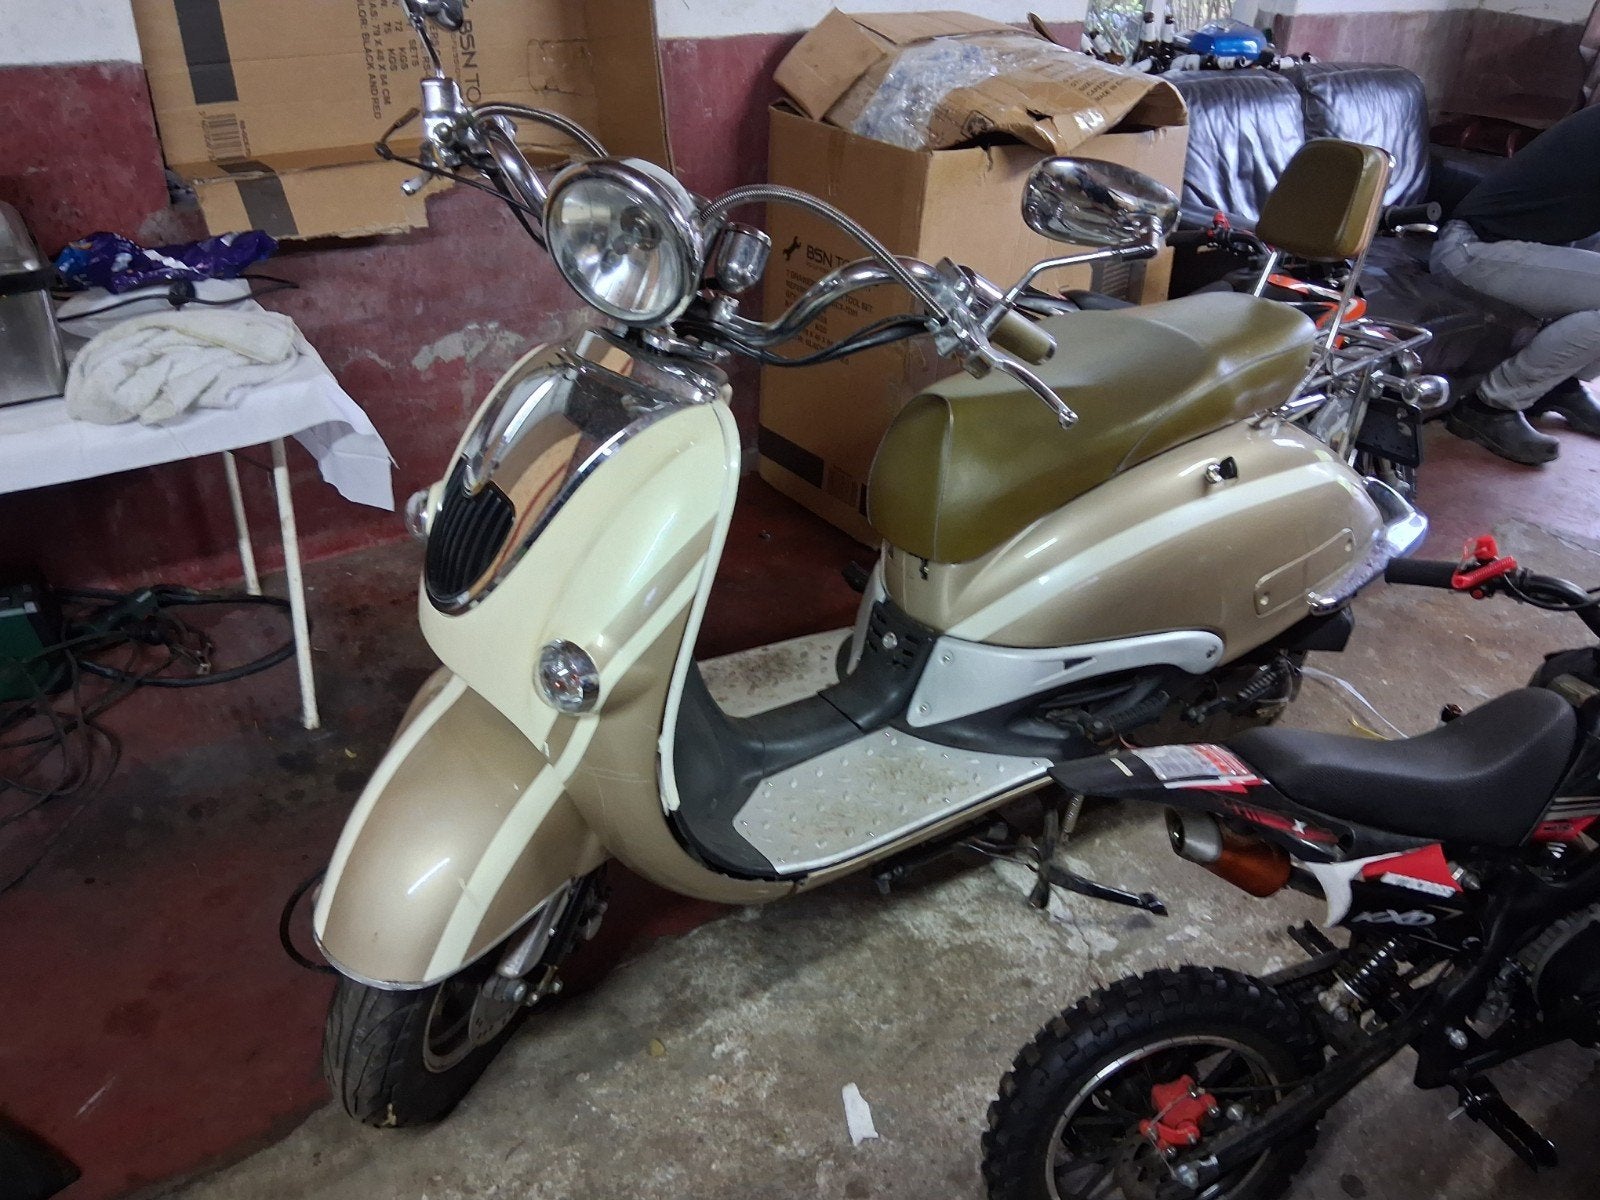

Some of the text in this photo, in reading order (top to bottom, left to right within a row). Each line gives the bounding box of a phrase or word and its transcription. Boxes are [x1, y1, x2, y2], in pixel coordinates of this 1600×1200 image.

[362, 32, 375, 70] BLACK
[387, 48, 398, 72] KGS
[398, 46, 409, 71] KGS
[460, 20, 482, 104] BSN TO
[368, 73, 379, 96] AND
[373, 97, 382, 120] RED
[806, 244, 832, 268] BSN
